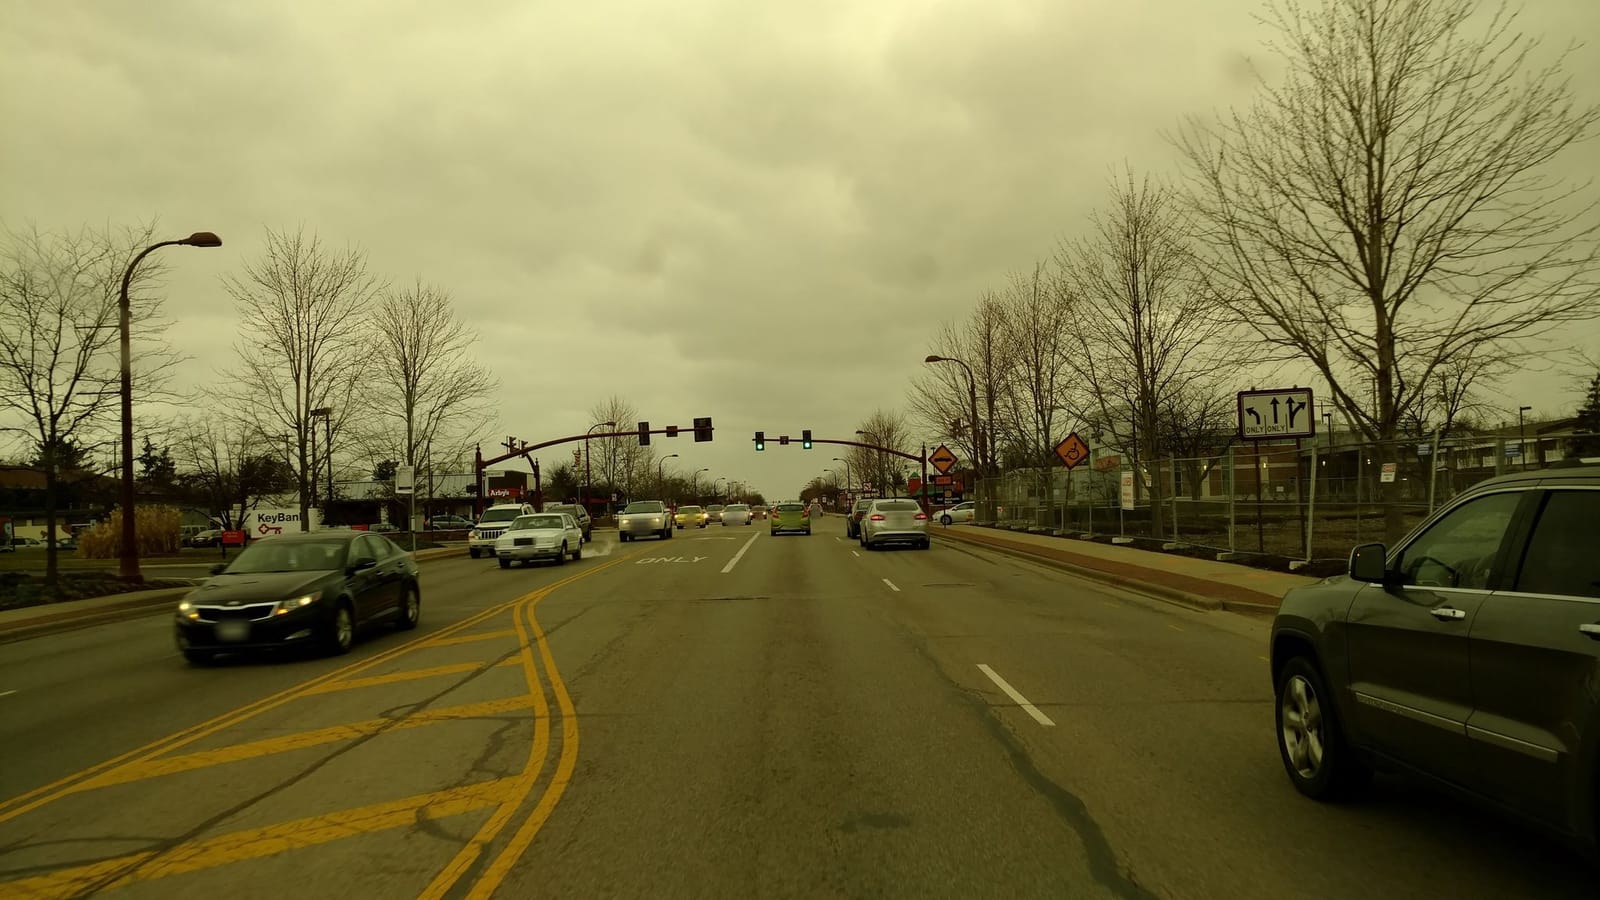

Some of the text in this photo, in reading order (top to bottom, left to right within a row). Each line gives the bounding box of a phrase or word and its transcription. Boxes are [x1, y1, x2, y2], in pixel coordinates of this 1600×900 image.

[1246, 425, 1286, 434] ONLY ONLY
[634, 556, 709, 564] ONLY
